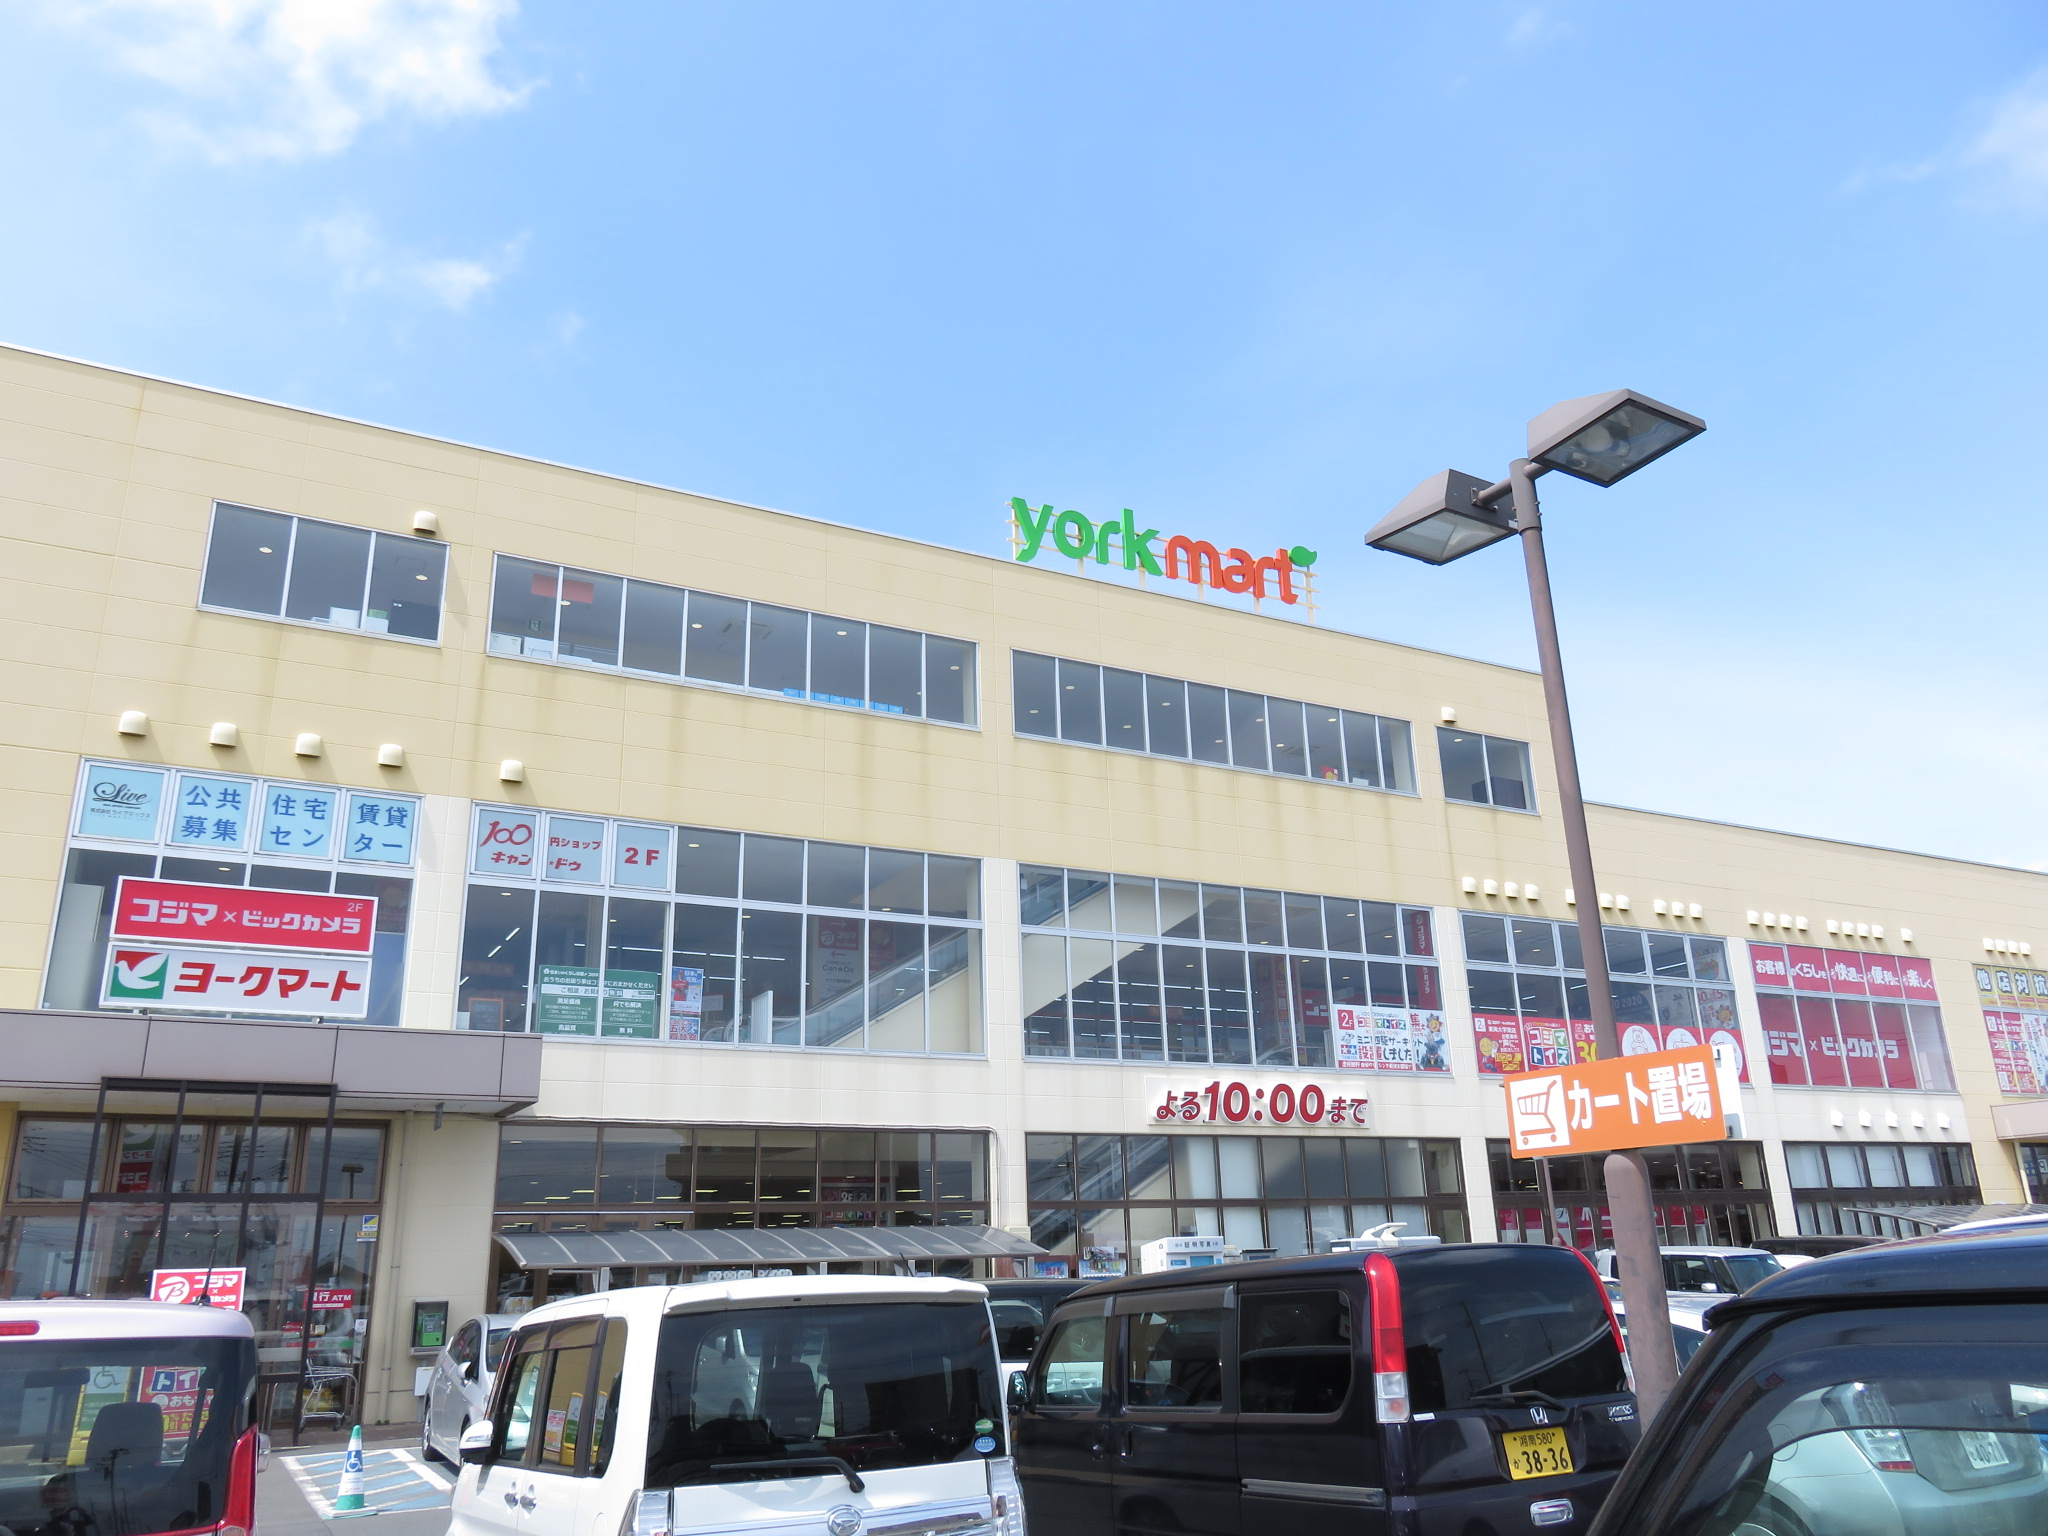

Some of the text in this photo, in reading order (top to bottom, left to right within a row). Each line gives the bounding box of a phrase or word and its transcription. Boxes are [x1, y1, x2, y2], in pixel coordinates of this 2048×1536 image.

[186, 785, 409, 829] 公共 住宅 賃貸
[180, 815, 238, 842] 募集
[347, 902, 364, 913] 2F
[173, 961, 362, 1002] ヨークマート
[1341, 1012, 1354, 1028] 2F
[1567, 1061, 1714, 1131] カート置場
[1184, 1240, 1212, 1249] 証明写真
[194, 1274, 239, 1289] コジマ
[331, 1294, 352, 1302] ATM
[1513, 1446, 1569, 1475] か 38-36
